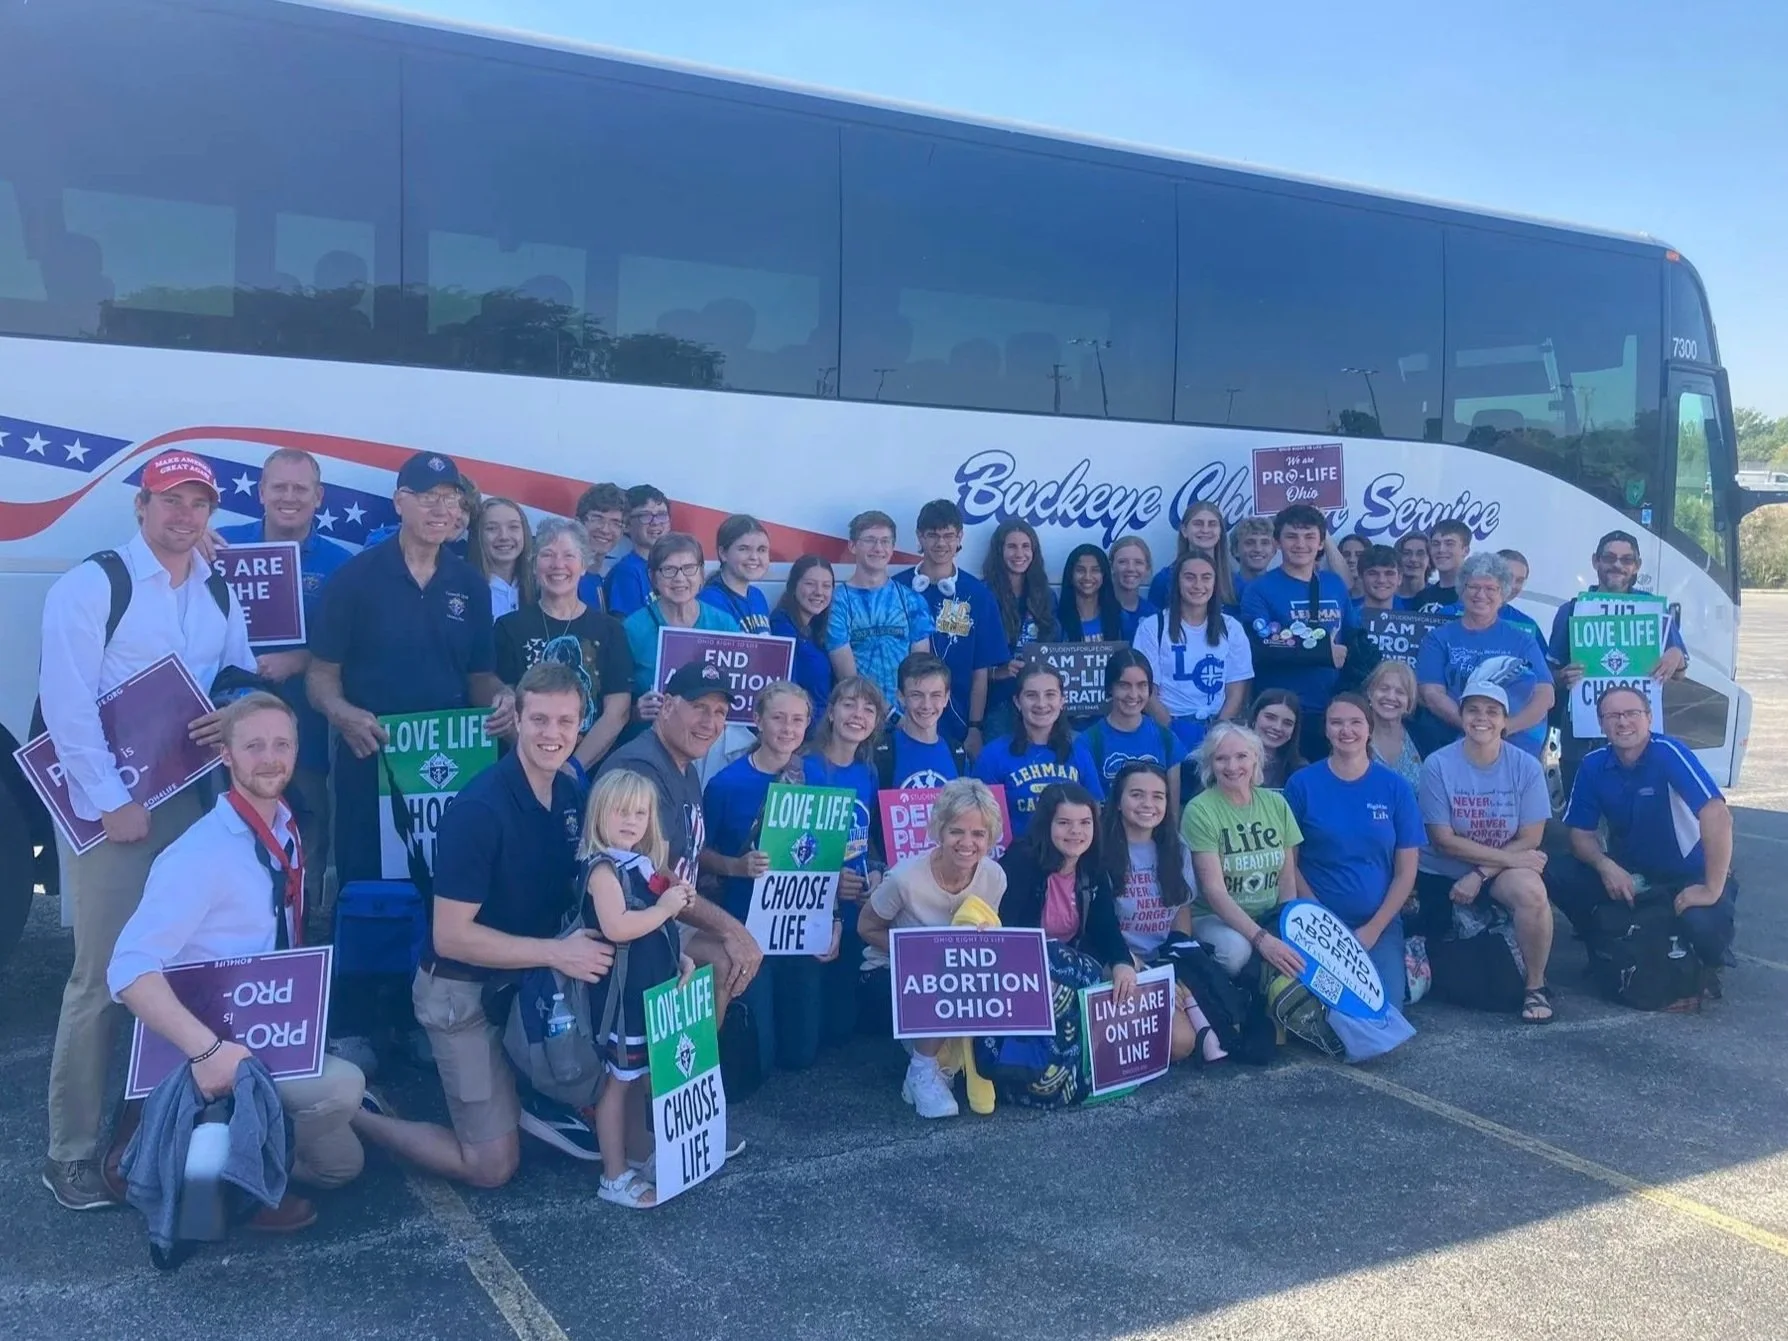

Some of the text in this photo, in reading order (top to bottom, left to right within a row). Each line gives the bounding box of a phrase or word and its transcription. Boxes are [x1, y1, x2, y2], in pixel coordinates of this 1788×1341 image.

[1673, 338, 1698, 360] 7300
[155, 457, 180, 468] MAKE
[160, 464, 189, 474] GREAT
[1286, 456, 1315, 467] We are
[954, 449, 1163, 549] Buckeye
[1354, 472, 1501, 541] Service
[1286, 485, 1319, 503] Ohio
[234, 556, 284, 577] ARE
[1370, 620, 1375, 632] I
[1384, 622, 1415, 636] AM
[1574, 619, 1655, 648] LOVE LIFE
[704, 649, 749, 669] END
[1047, 654, 1075, 668] AM
[384, 714, 493, 754] LOVE LIFE
[120, 746, 135, 759] is
[1010, 762, 1079, 788] LEHMAN
[768, 791, 852, 832] LOVE LIFE
[1453, 796, 1490, 807] NEVER
[1470, 818, 1507, 829] NEVER
[1223, 859, 1231, 872] A
[761, 875, 831, 911] CHOOSE
[768, 915, 807, 951] LIFE
[1310, 912, 1332, 938] TO
[1336, 938, 1370, 975] END
[1323, 912, 1364, 956] PRAY
[944, 948, 997, 968] END
[1291, 916, 1381, 998] ABORTION
[223, 978, 293, 1008] PRO-
[903, 973, 1040, 995] ABORTION
[648, 975, 713, 1045] LOVE LIFE
[934, 998, 1013, 1019] OHIO!
[1095, 989, 1165, 1021] LIVES ARE
[223, 1012, 234, 1025] is
[1105, 1014, 1160, 1043] ON THE
[235, 1019, 309, 1050] PRO-
[1118, 1040, 1151, 1066] LINE
[663, 1074, 720, 1143] CHOOSE
[681, 1129, 712, 1186] LIFE
